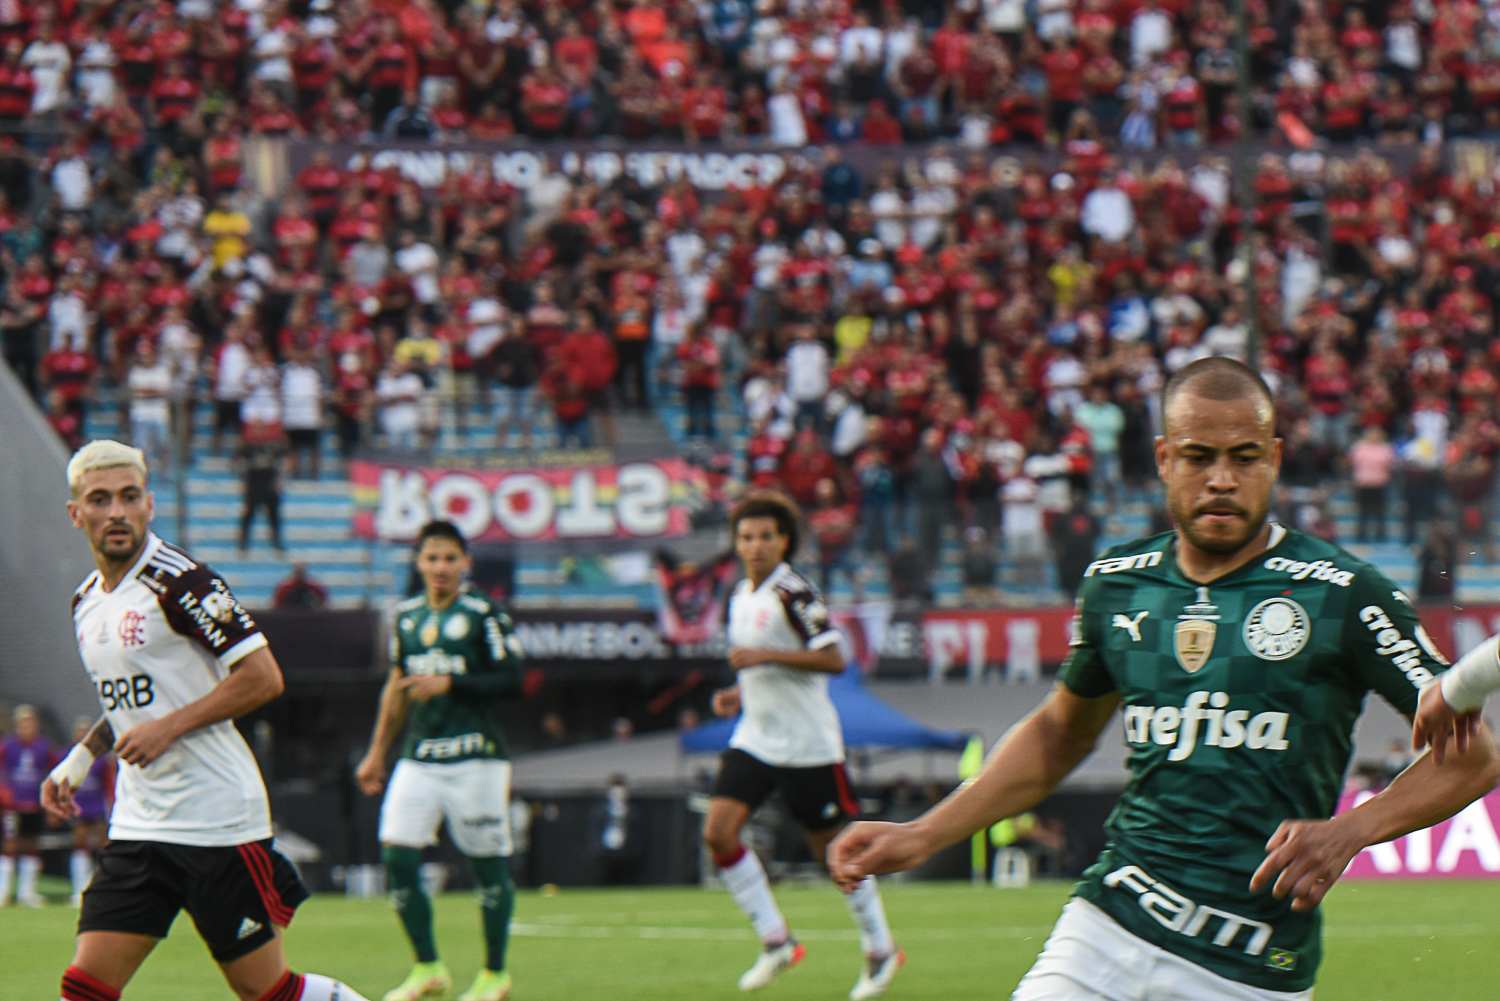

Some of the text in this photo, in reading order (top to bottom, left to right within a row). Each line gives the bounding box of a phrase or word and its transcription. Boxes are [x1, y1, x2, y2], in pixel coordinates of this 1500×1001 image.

[1263, 555, 1356, 588] crefisa
[178, 590, 228, 648] HAVAN
[1358, 604, 1436, 689] crefisa
[100, 673, 155, 712] BRB
